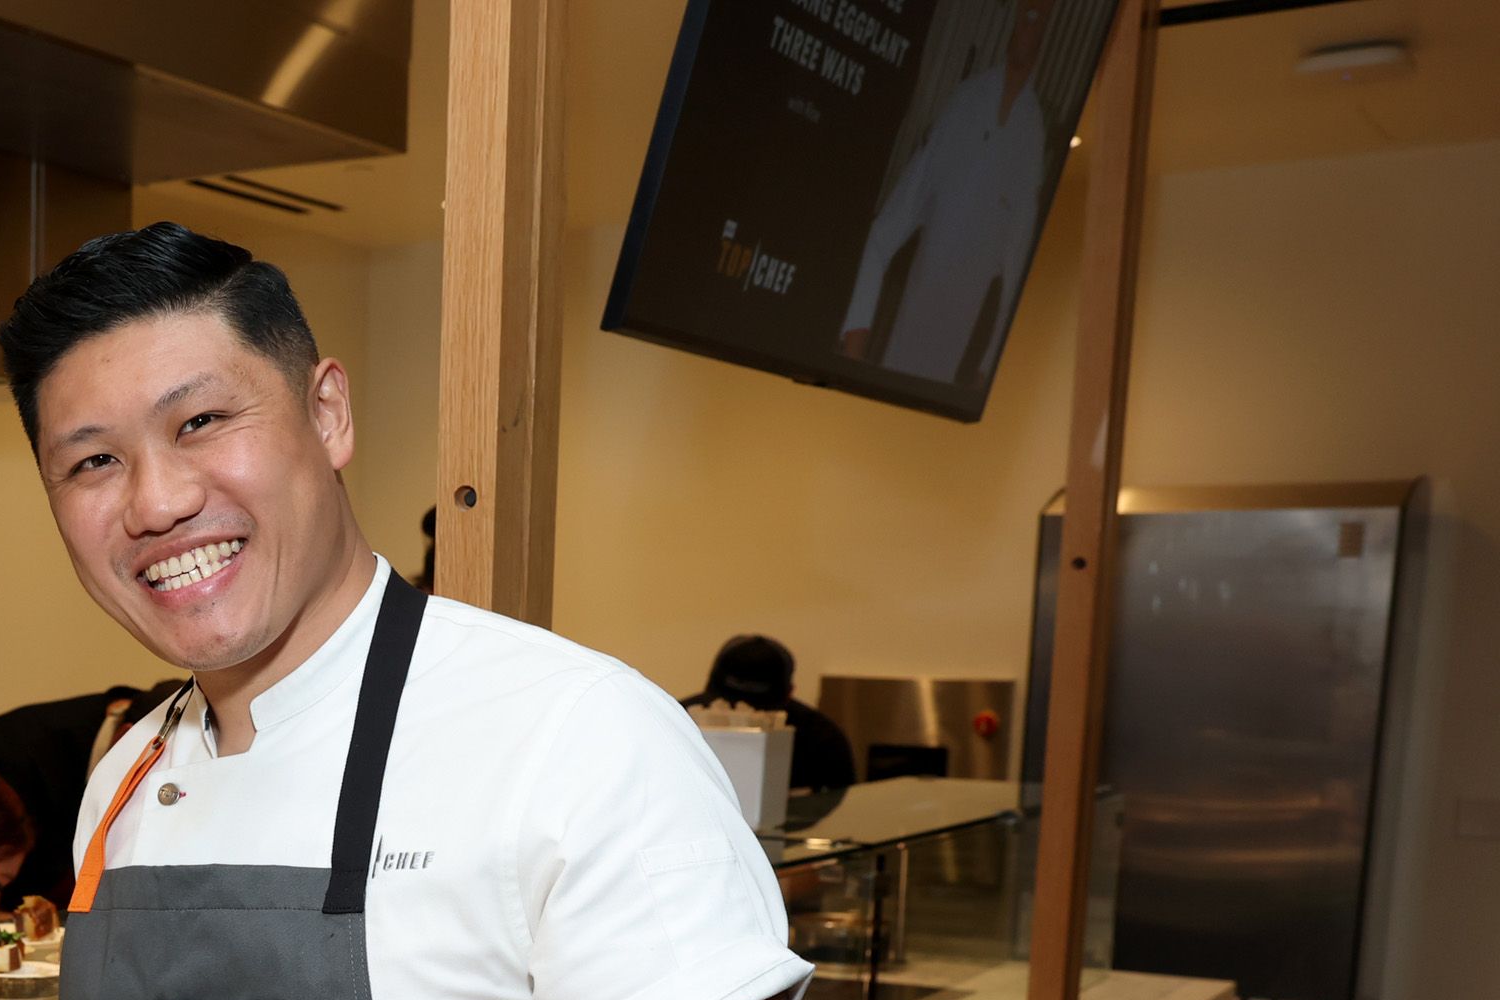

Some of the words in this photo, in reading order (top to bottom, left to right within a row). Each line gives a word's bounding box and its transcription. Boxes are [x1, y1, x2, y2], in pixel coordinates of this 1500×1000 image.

[770, 15, 822, 71] THREE
[821, 46, 866, 96] WAYS
[833, 0, 910, 68] EGGPLANT
[716, 240, 752, 279] TOP
[753, 254, 797, 294] CHEF
[383, 851, 436, 872] CHEF
